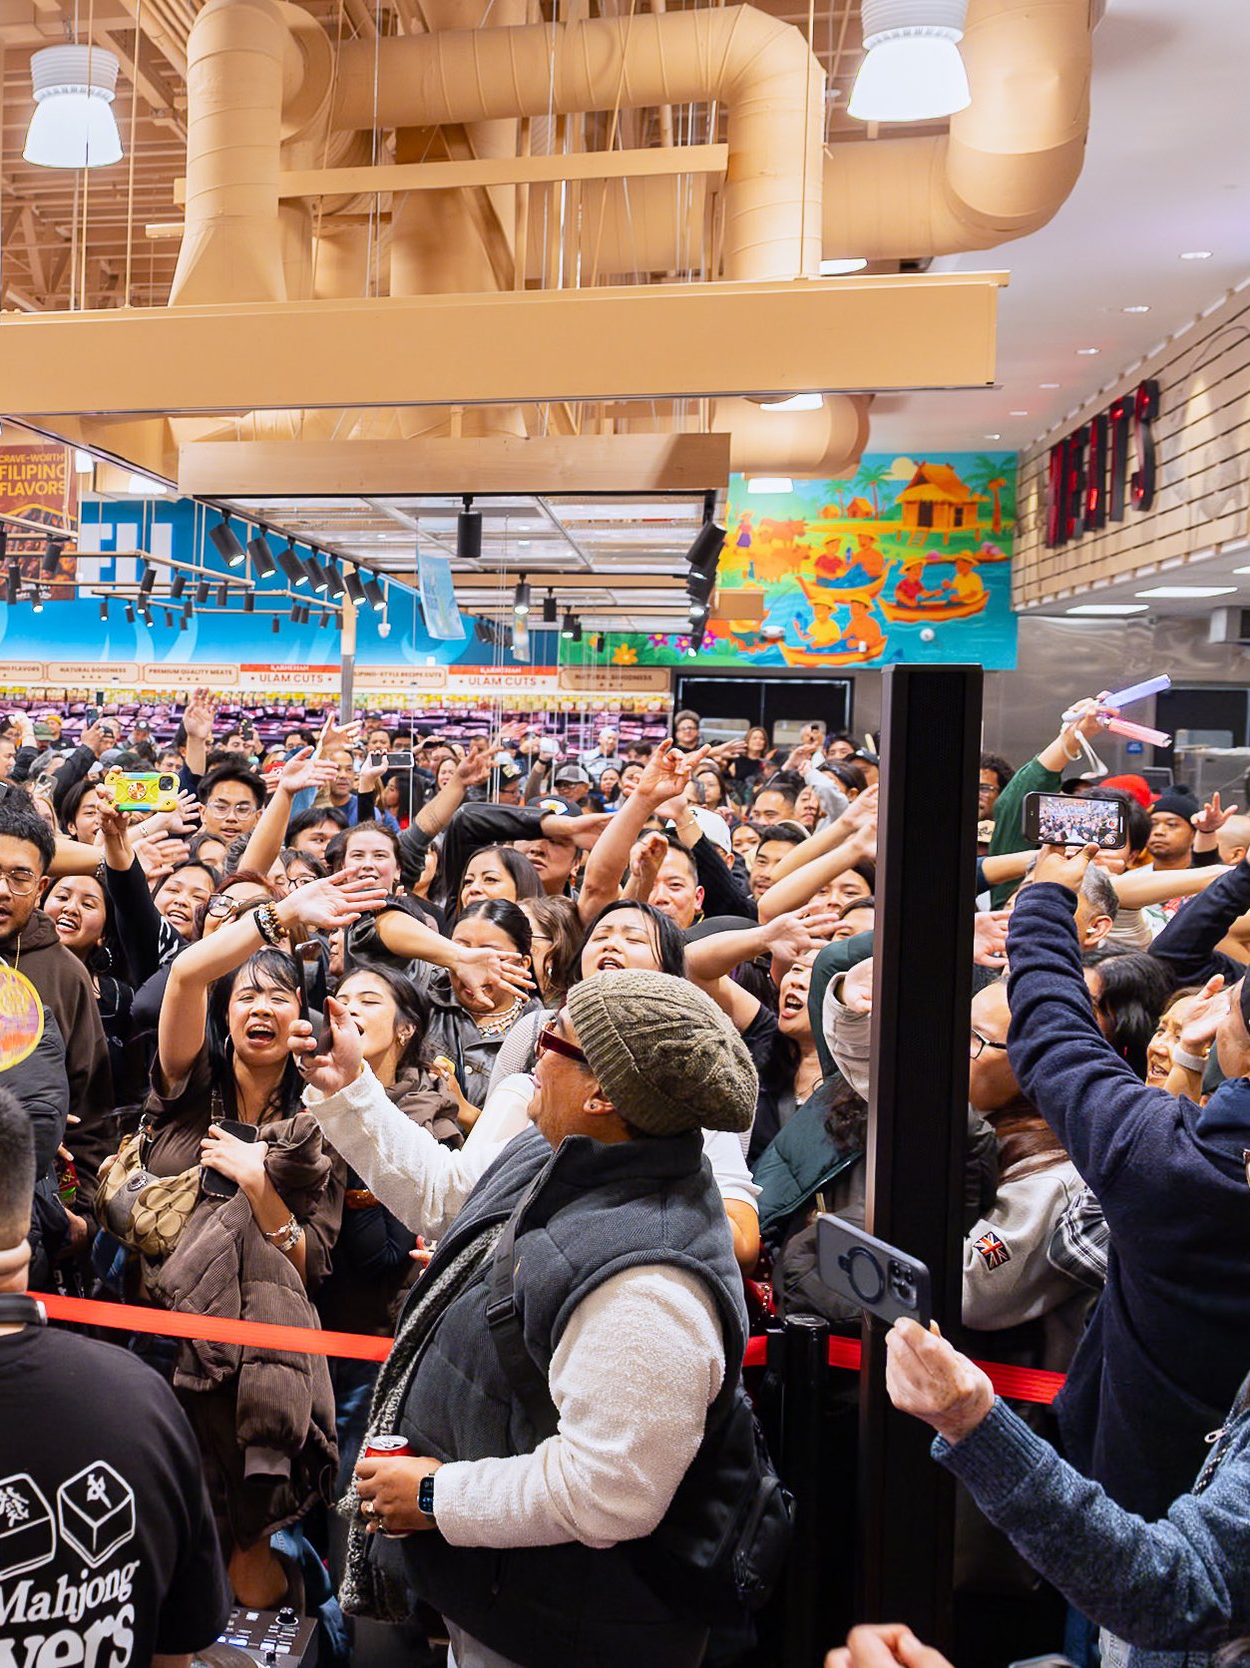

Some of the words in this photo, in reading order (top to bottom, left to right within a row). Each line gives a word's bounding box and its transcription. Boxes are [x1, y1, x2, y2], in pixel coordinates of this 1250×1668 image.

[180, 668, 209, 676] QUALITY
[259, 673, 291, 683] ULAM
[293, 674, 324, 683] CUTS
[468, 676, 502, 686] ULAM
[505, 676, 537, 686] CUTS
